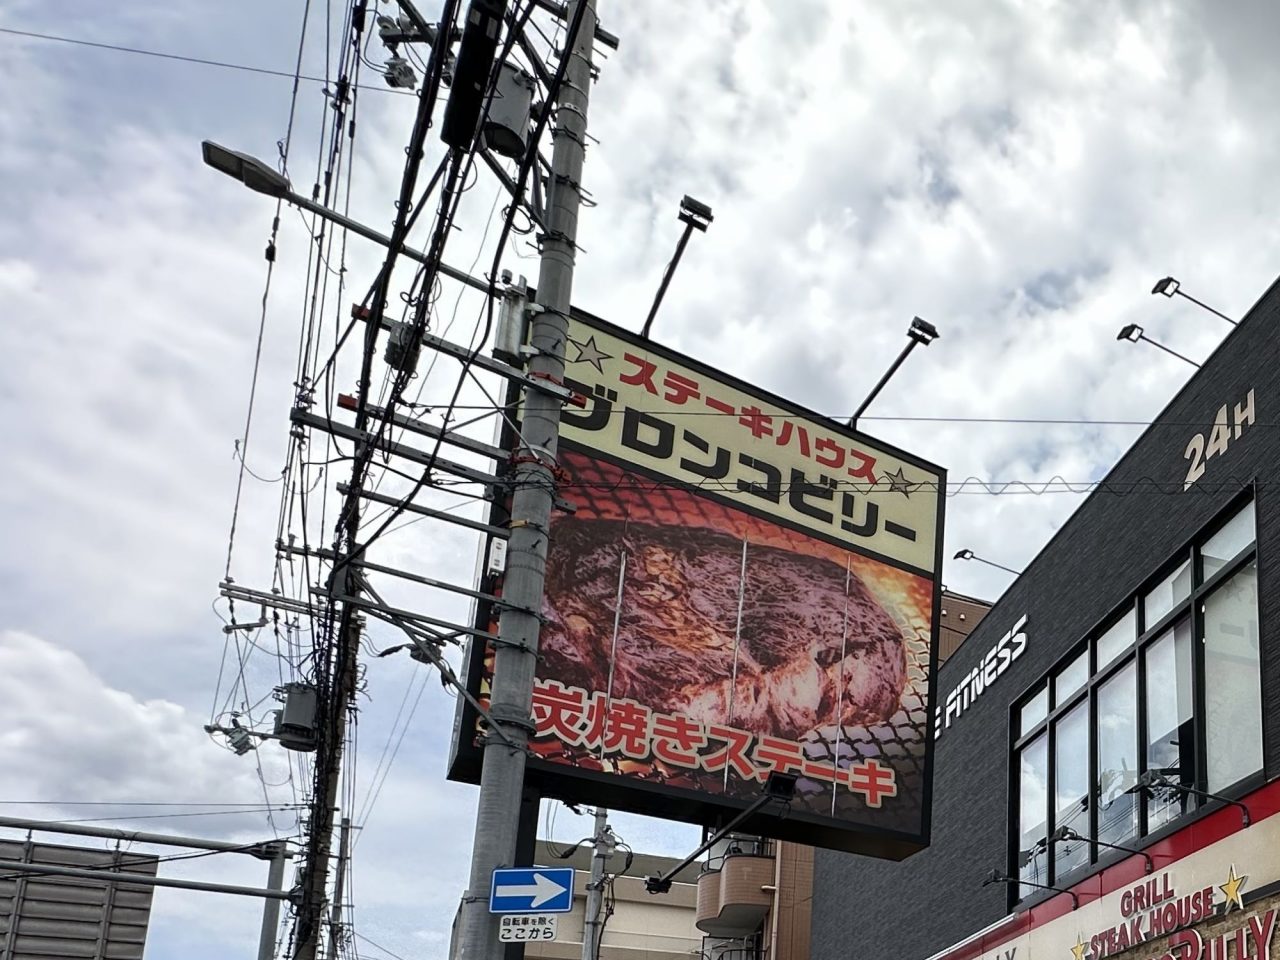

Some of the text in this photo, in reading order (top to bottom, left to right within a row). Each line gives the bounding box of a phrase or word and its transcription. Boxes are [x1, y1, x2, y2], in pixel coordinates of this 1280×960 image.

[556, 382, 918, 543] ブロンコビリー
[619, 352, 879, 485] ステーキハウス
[1183, 387, 1256, 492] 24H
[944, 613, 1028, 729] FITNESS
[530, 684, 894, 806] 炭焼きステーキ
[501, 927, 554, 940] ここから
[502, 916, 554, 927] 自転車を除く
[1120, 872, 1176, 918] GRILL
[1149, 886, 1217, 938] HOUSE
